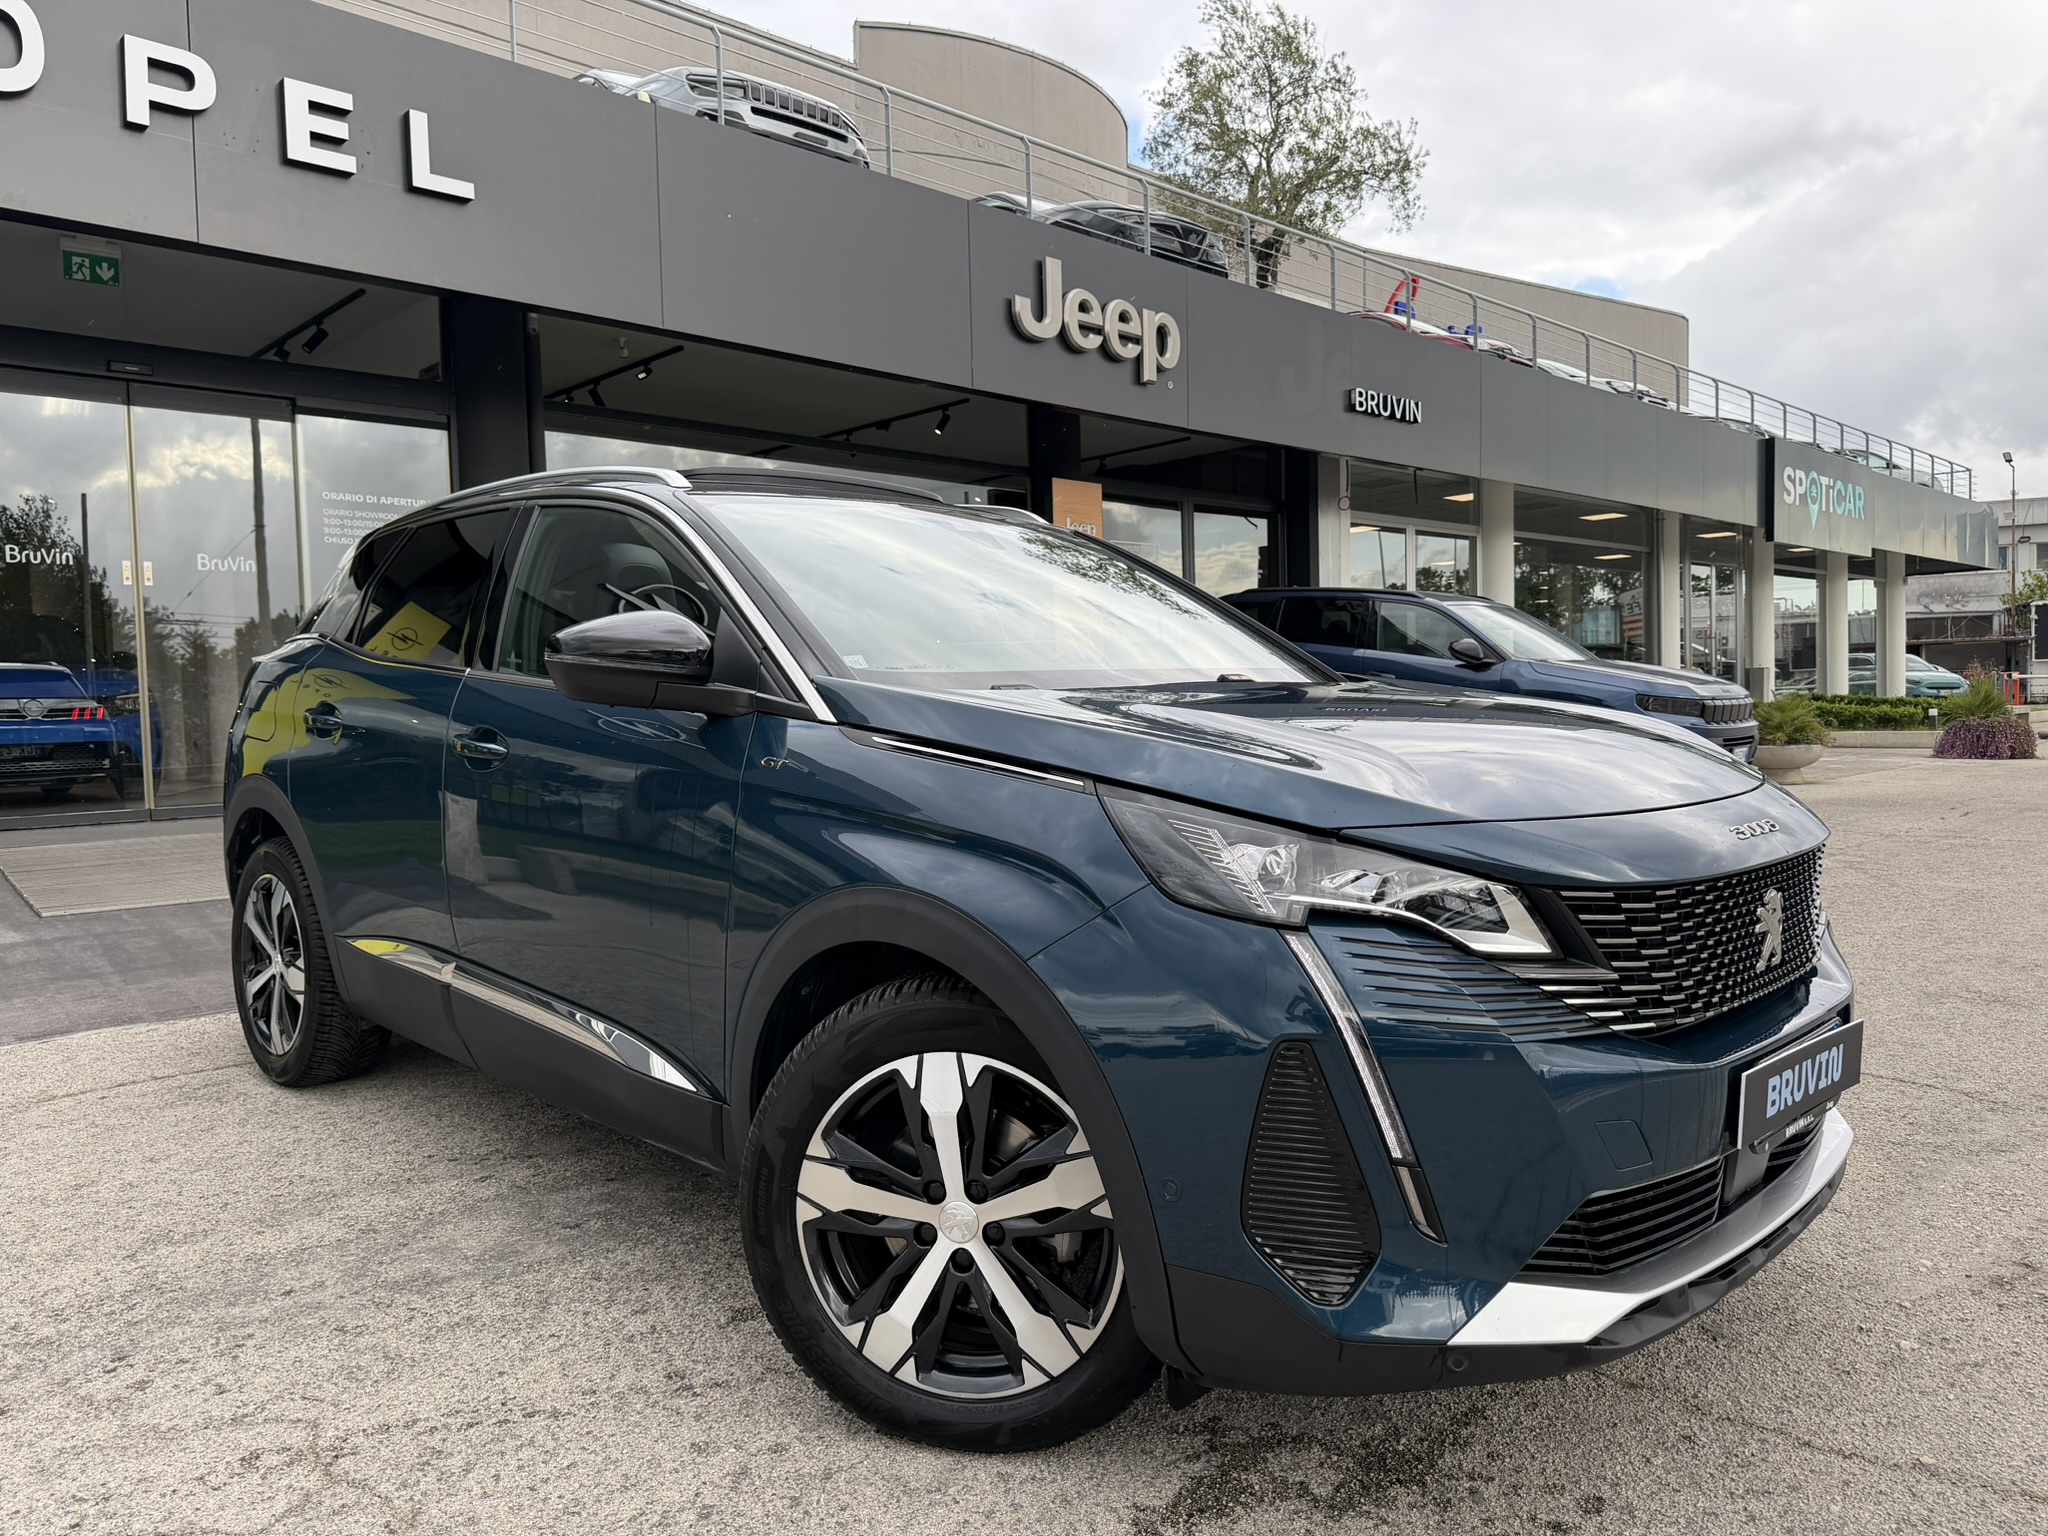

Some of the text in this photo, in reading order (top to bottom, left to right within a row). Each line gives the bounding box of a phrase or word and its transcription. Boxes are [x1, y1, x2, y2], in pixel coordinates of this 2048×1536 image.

[1011, 256, 1181, 385] Jeep
[1353, 387, 1422, 424] BRUVIN
[322, 491, 364, 502] ORARIO
[366, 495, 378, 504] DI
[323, 508, 353, 517] ORARIO
[324, 536, 354, 545] CHIUSO
[4, 544, 74, 566] BruVin
[196, 553, 256, 573] BruVin
[761, 756, 789, 770] GT
[1729, 819, 1779, 840] 3008
[1766, 1043, 1844, 1118] BRUVIN
[774, 1297, 889, 1419] BRIDGESTONE
